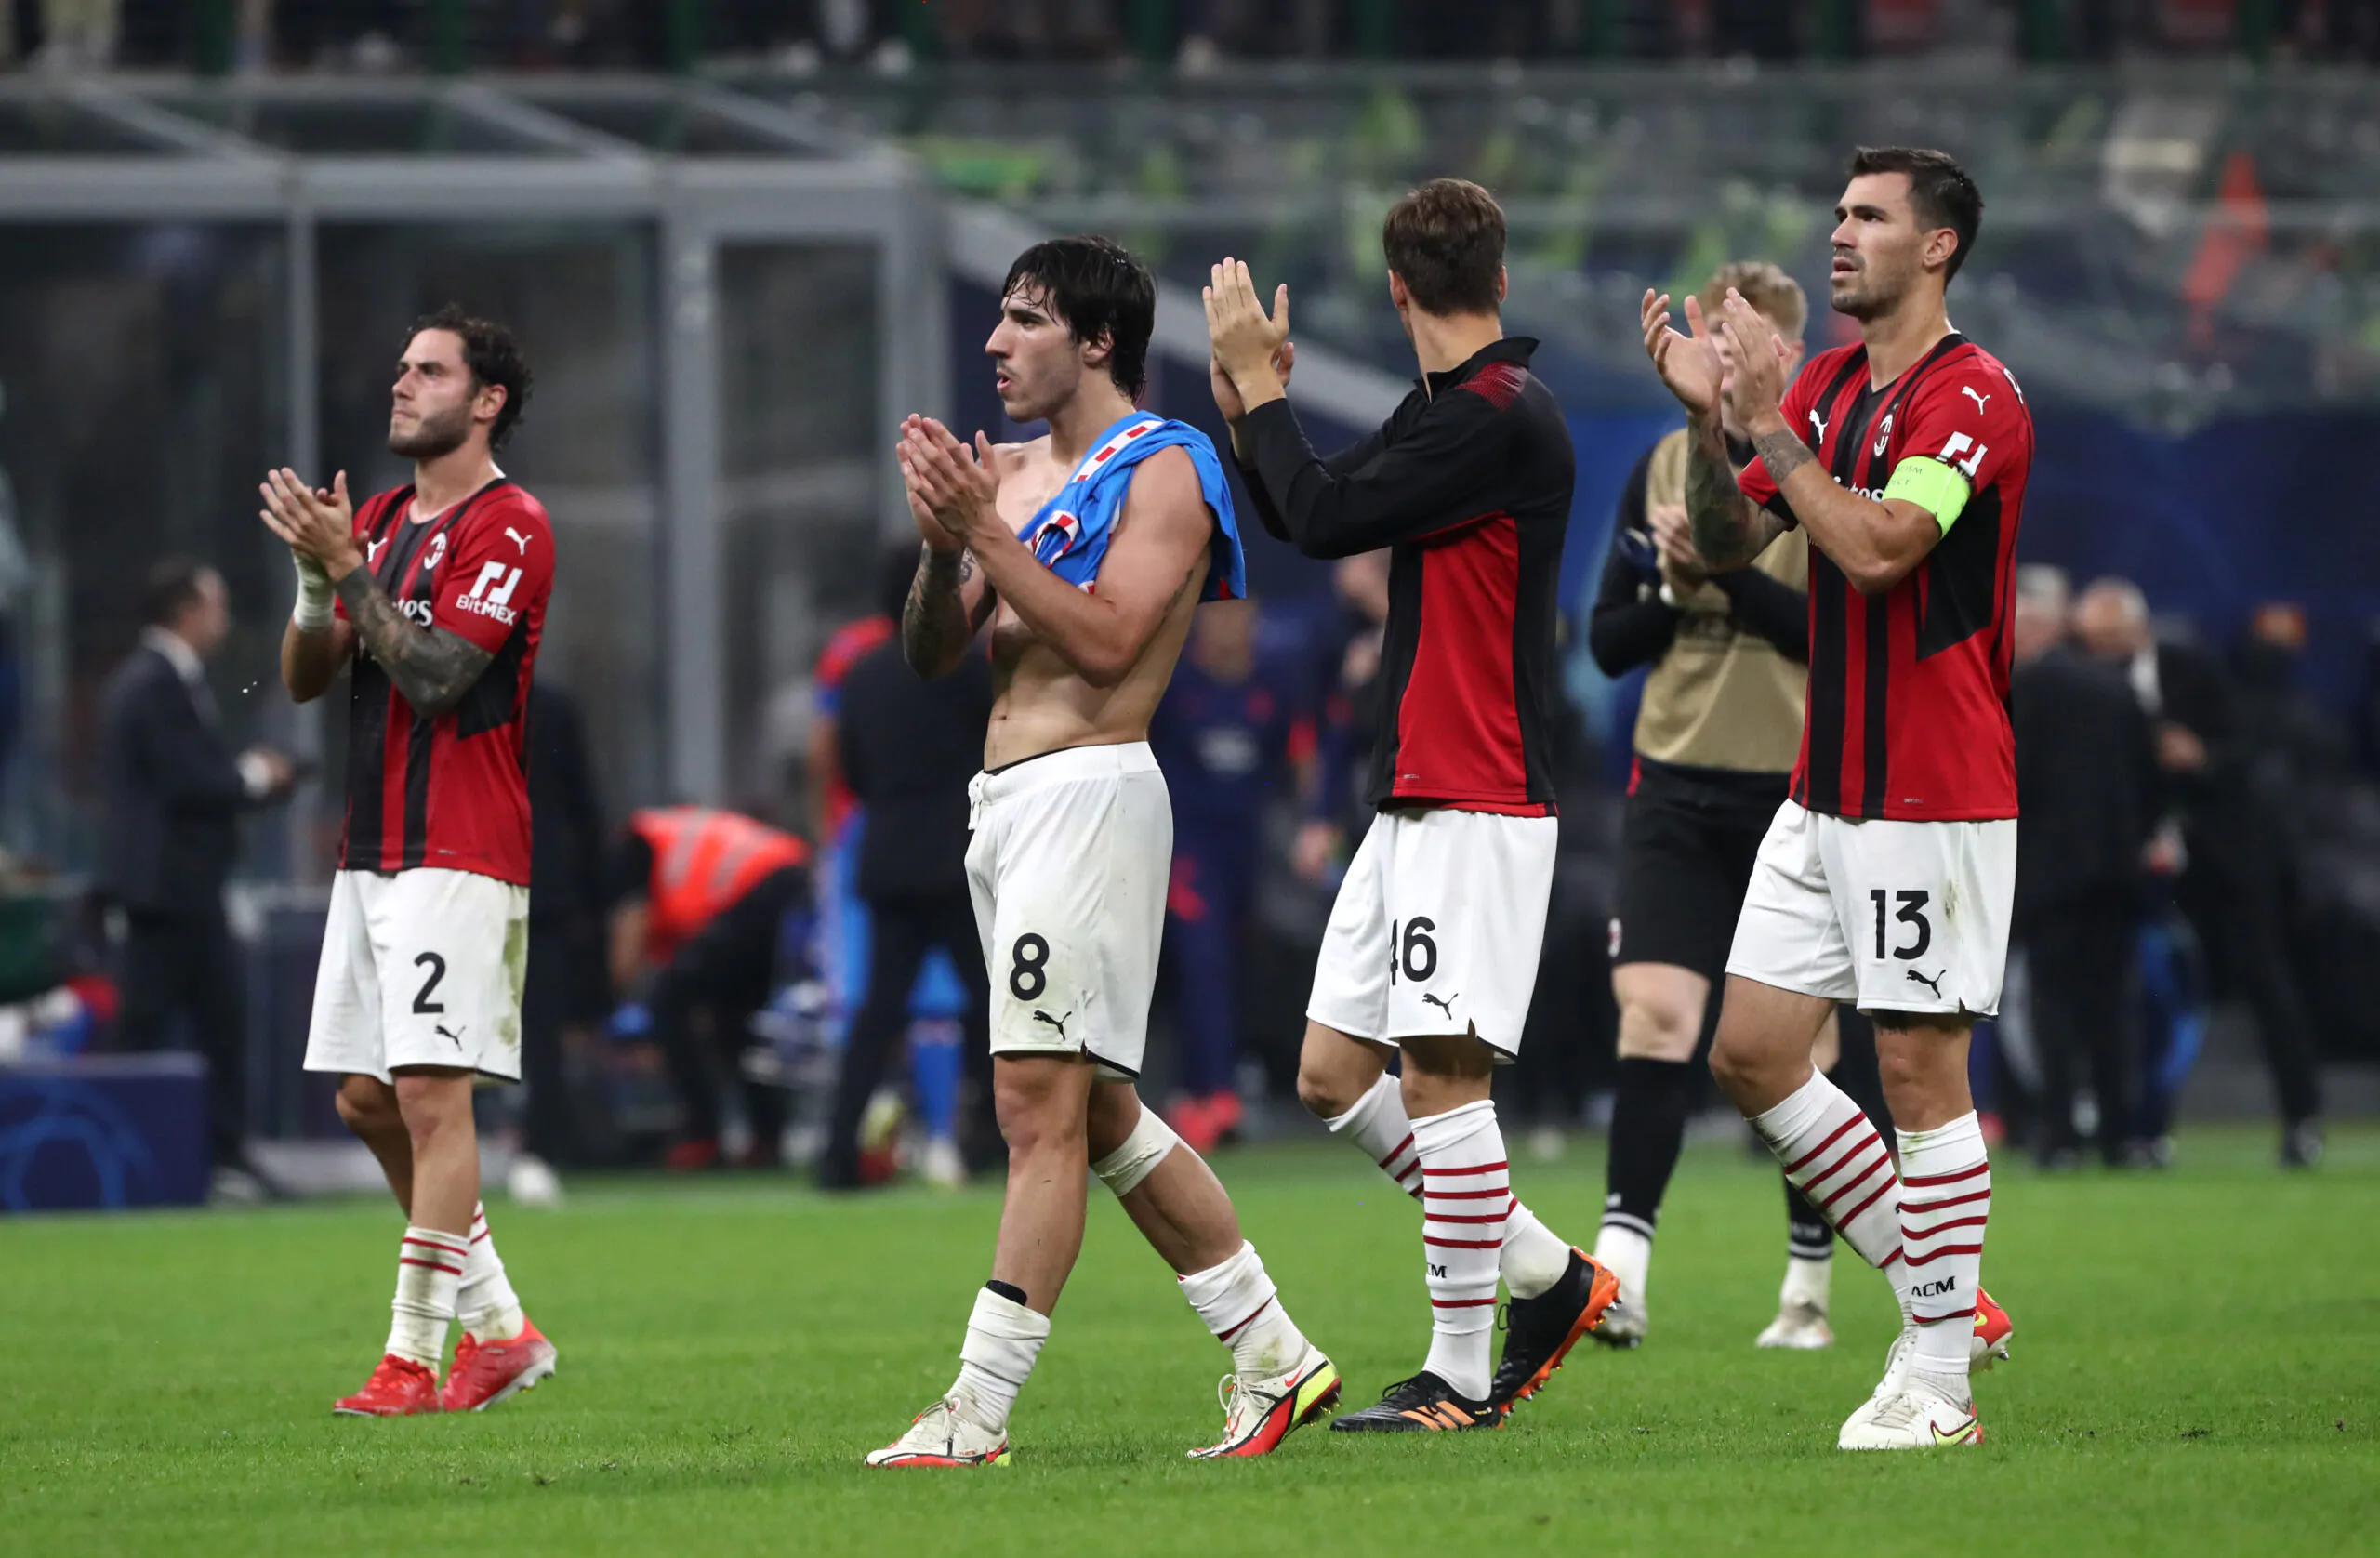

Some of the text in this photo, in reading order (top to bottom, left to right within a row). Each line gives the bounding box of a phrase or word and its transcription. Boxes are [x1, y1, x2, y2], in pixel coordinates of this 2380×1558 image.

[456, 594, 517, 627] BitMEX
[1870, 889, 1931, 960] 13
[412, 951, 446, 1014] 2
[1010, 932, 1050, 1001] 8
[1911, 1275, 1956, 1297] ACM
